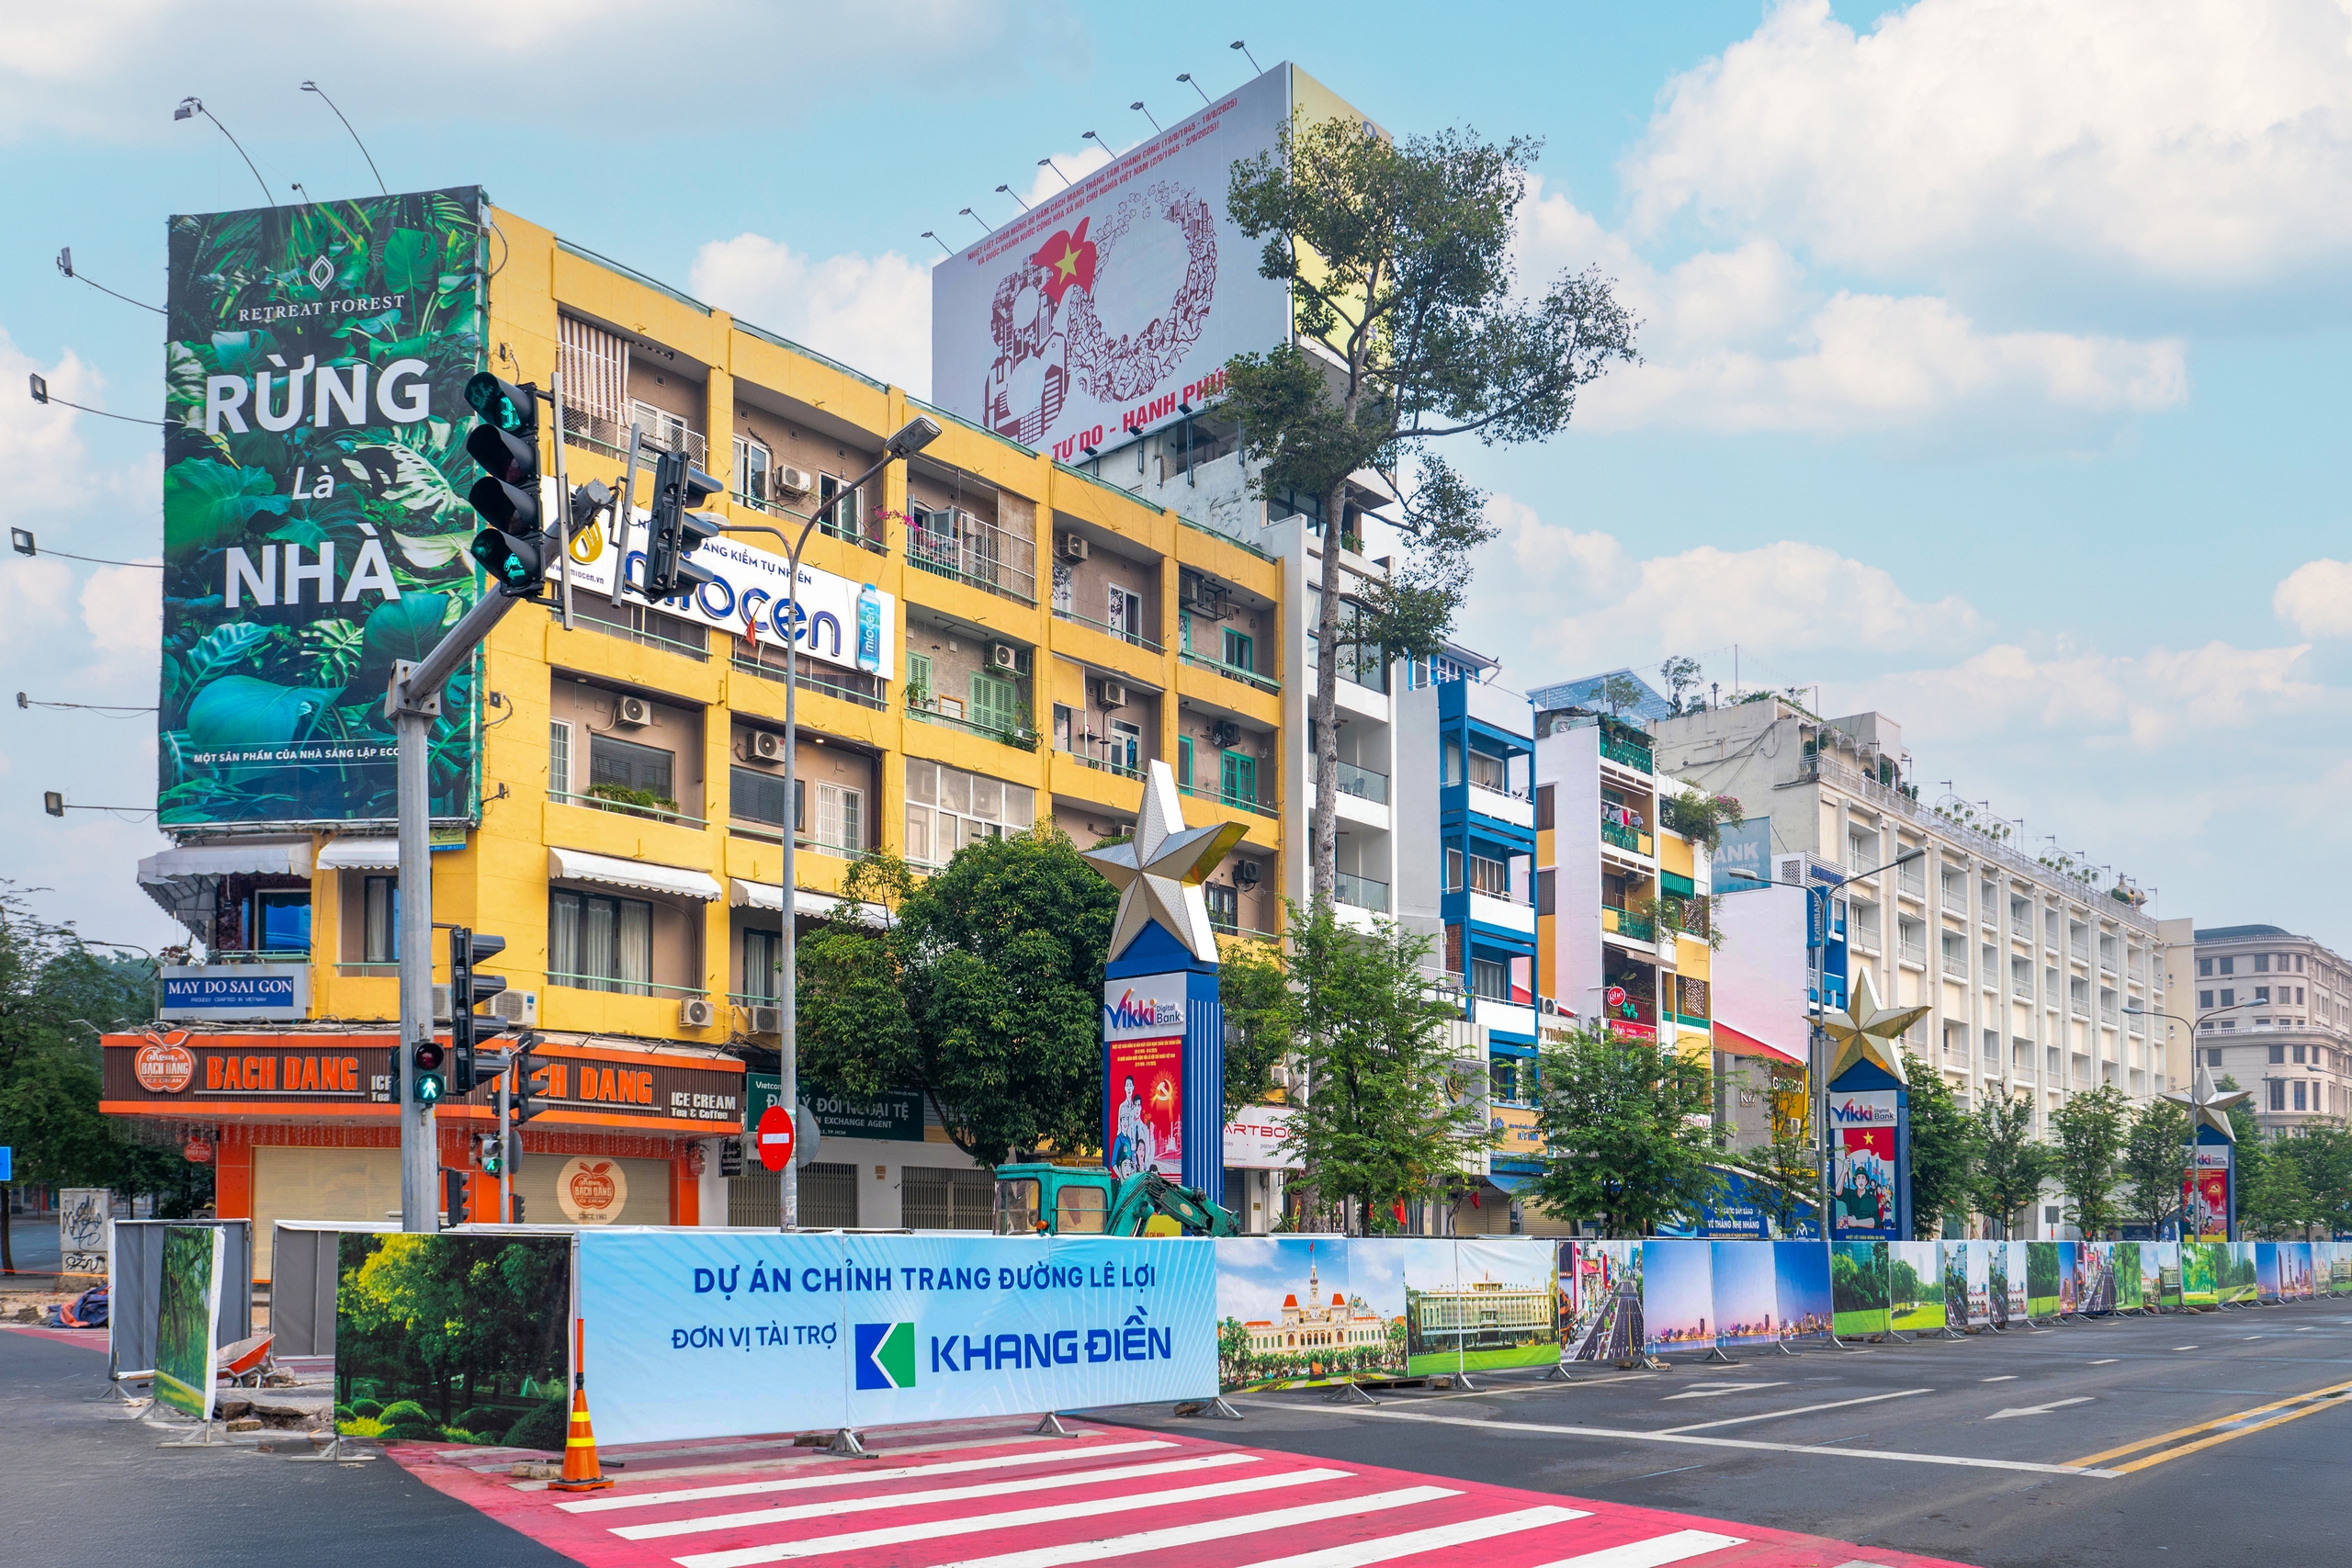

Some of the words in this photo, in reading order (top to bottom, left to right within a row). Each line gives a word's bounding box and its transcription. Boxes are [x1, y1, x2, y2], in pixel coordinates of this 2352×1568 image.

[967, 247, 983, 262] NHIỆT
[983, 242, 995, 255] LIỆT
[996, 231, 1010, 247] CHÀO
[1011, 220, 1027, 240] MỪNG
[1028, 216, 1035, 227] 80
[1036, 208, 1050, 223] NĂM
[1051, 197, 1067, 215] CÁCH
[1068, 186, 1085, 203] MẠNG
[1085, 175, 1105, 194] THÁNG
[1106, 165, 1120, 182] TÁM
[1121, 153, 1142, 173] THÀNH
[1143, 142, 1160, 160] CÔNG
[1161, 121, 1196, 149] (19/8/1945
[1202, 97, 1238, 124] 19/8/2025)
[978, 254, 986, 266] VÀ
[986, 246, 1001, 263] QUỐC
[1001, 236, 1020, 254] KHÁNH
[1020, 227, 1035, 243] NƯỚC
[1036, 219, 1052, 233] CỘNG
[1053, 209, 1065, 224] HÒA
[1066, 204, 1074, 216] XÃ
[1075, 197, 1085, 210] HỘI
[1086, 188, 1099, 203] CHỦ
[1100, 178, 1118, 195] NGHĨA
[1119, 169, 1133, 185] VIỆT
[1134, 162, 1148, 176] NAM
[1149, 143, 1181, 169] (2/9/1945
[1185, 120, 1220, 147] 2/9/2025)!
[239, 301, 323, 321] RETREAT
[330, 294, 405, 314] FOREST
[206, 353, 430, 435] RỪNG
[1052, 434, 1076, 463] TỰ
[1079, 424, 1103, 451] DO
[1123, 392, 1176, 433] HẠNH
[1182, 367, 1231, 405] PHÚ
[293, 465, 334, 501] Là
[225, 522, 401, 608] NHÀ
[730, 548, 758, 568] KIỀM
[761, 559, 775, 575] TỰ
[778, 566, 812, 585] NHÊN
[864, 606, 875, 653] miocen
[194, 752, 216, 765] MỘT
[220, 750, 240, 762] SẢN
[243, 749, 273, 761] PHẨM
[276, 748, 298, 761] CỦA
[300, 748, 323, 760] NHÀ
[325, 747, 355, 759] SÁNG
[356, 747, 377, 760] LẬP
[168, 981, 200, 995] MAY
[205, 981, 227, 994] DO
[230, 981, 254, 994] SAI
[258, 979, 293, 993] GON
[1104, 987, 1156, 1030] Vikki
[1156, 1003, 1176, 1012] Digital
[1156, 1013, 1181, 1024] Bank
[206, 1056, 276, 1091] BACH
[283, 1056, 358, 1092] DANG
[581, 1066, 652, 1104] DANG
[371, 1091, 390, 1102] Tea
[671, 1091, 691, 1107] ICE
[693, 1093, 736, 1110] CREAM
[671, 1107, 687, 1118] Tea
[690, 1108, 696, 1118] &
[699, 1109, 728, 1120] Coffee
[893, 1101, 909, 1122] TỆ
[1831, 1098, 1872, 1122] Vikki
[824, 1116, 865, 1127] EXCHANGE
[867, 1120, 892, 1129] AGENT
[1715, 1218, 1732, 1229] THÁNG
[1743, 1218, 1759, 1229] NHÀNG
[694, 1265, 741, 1301] DỰ
[749, 1264, 793, 1292] ÁN
[802, 1258, 891, 1291] CHỈNH
[900, 1267, 989, 1291] TRANG
[999, 1260, 1082, 1290] ĐƯỜNG
[1091, 1259, 1115, 1287] LÊ
[1121, 1261, 1157, 1293] LỢI
[672, 1326, 724, 1349] ĐƠN
[729, 1325, 751, 1354] VỊ
[755, 1320, 789, 1347] TÀI
[794, 1321, 838, 1349] TRỢ
[932, 1327, 1079, 1373] KHANG
[1085, 1304, 1171, 1362] ĐIỀN
